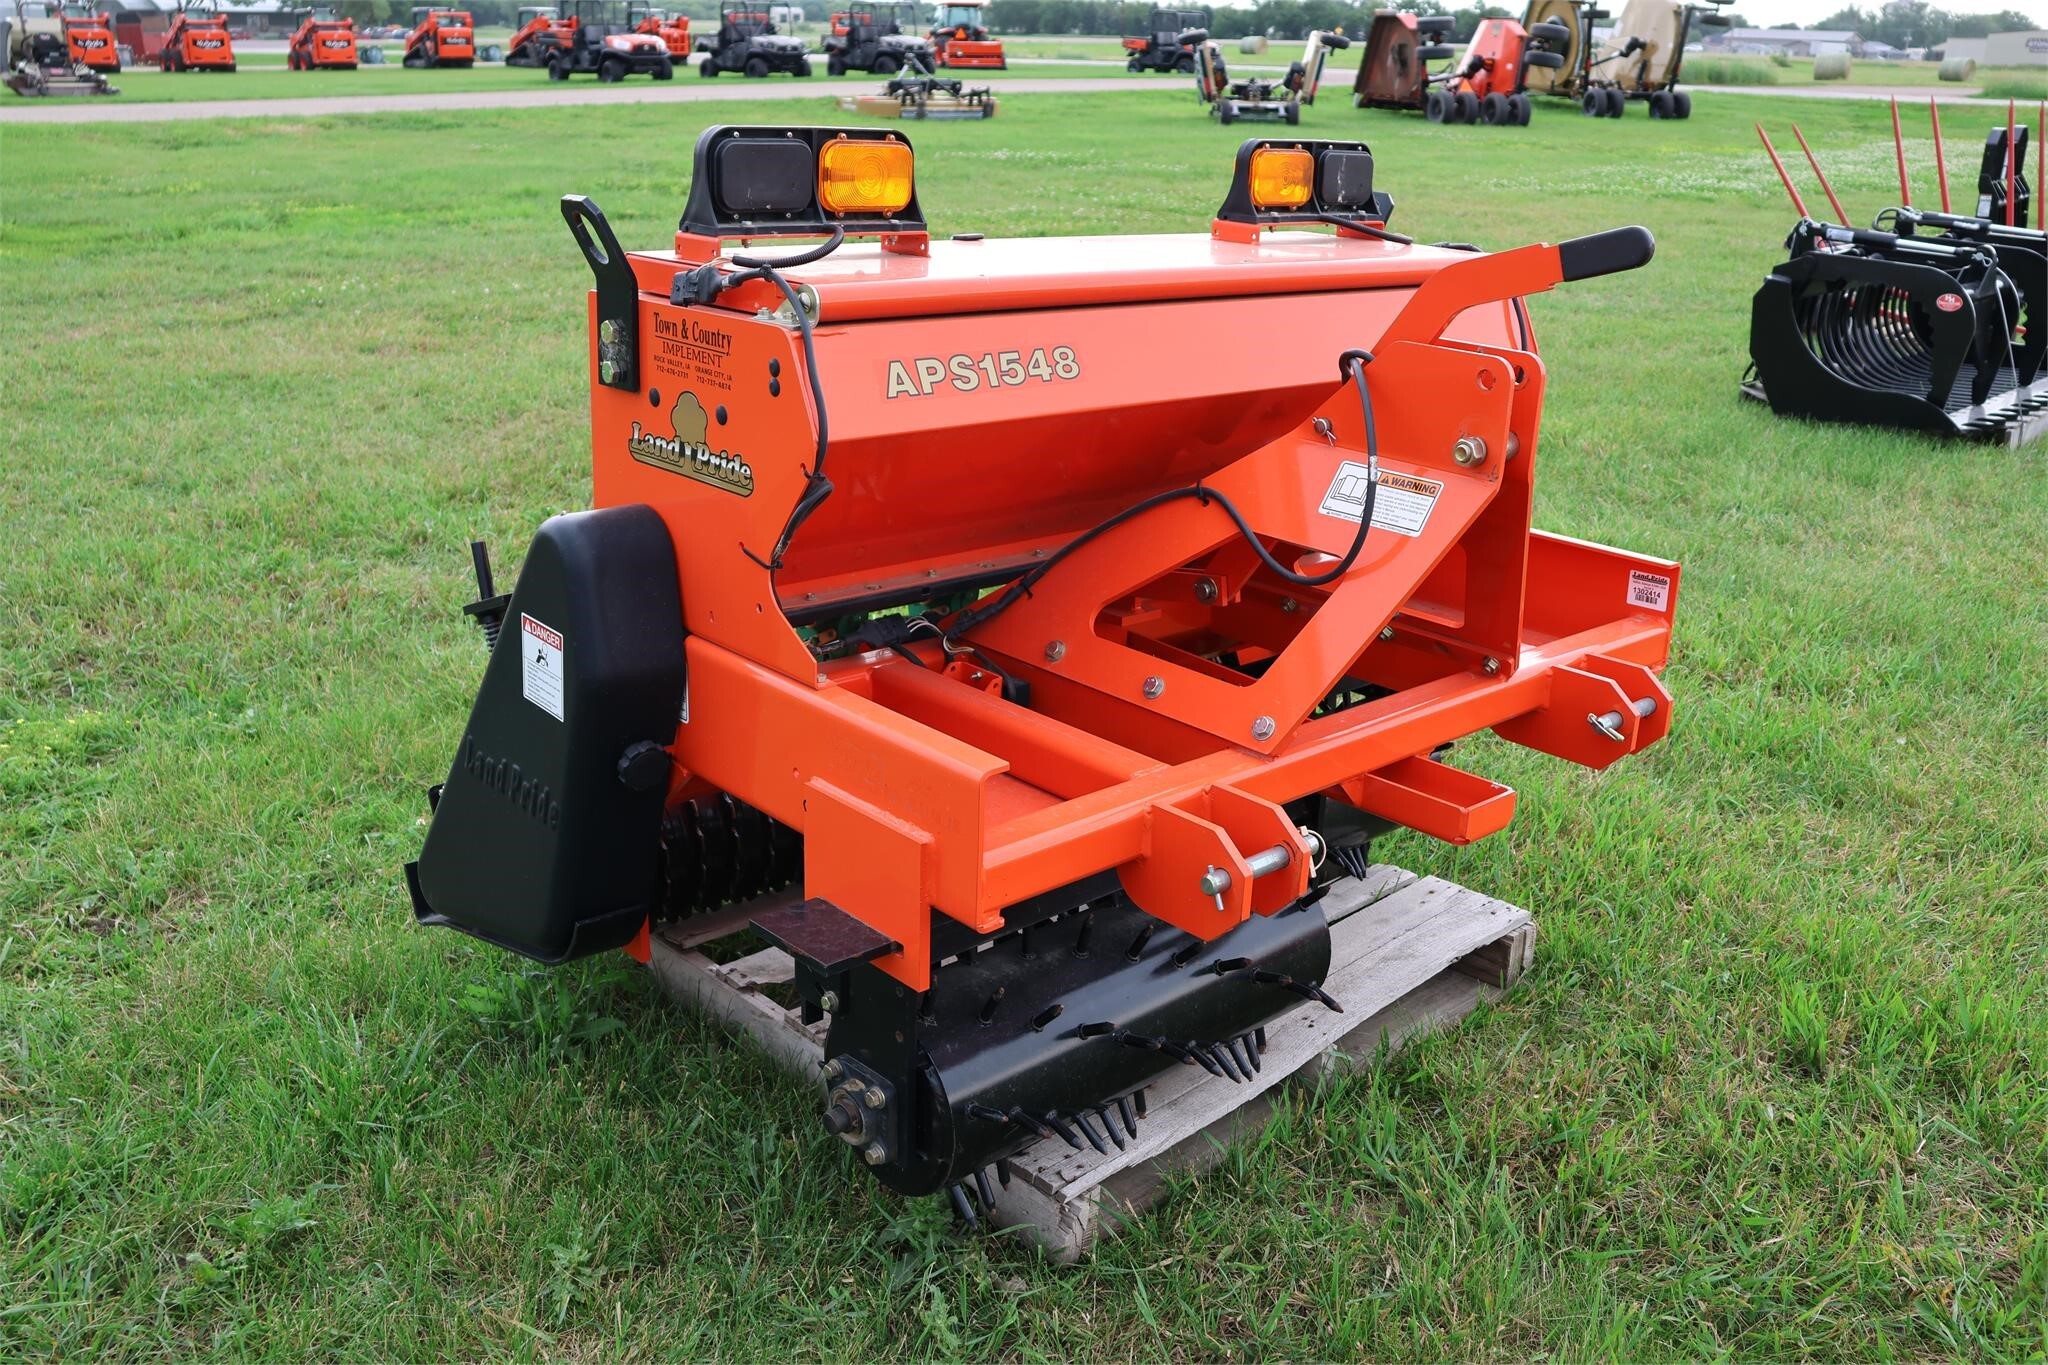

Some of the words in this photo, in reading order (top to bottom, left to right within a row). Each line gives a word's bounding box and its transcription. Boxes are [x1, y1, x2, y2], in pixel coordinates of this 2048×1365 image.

[653, 312, 678, 338] Town
[681, 318, 689, 340] &
[692, 321, 732, 356] Country
[654, 354, 665, 363] ROCK
[662, 341, 723, 368] IMPLEMENT
[694, 365, 713, 376] ORANGE
[714, 370, 726, 381] CITY,
[886, 345, 1080, 399] APS1548
[630, 421, 681, 463] Land
[696, 441, 753, 486] Pride
[1391, 476, 1437, 495] WARNING
[1632, 571, 1650, 580] Land
[1652, 575, 1668, 585] Pride
[1633, 586, 1661, 599] 1302414
[531, 623, 561, 649] DANGER
[464, 735, 507, 789] Land
[508, 763, 560, 832] Pride
